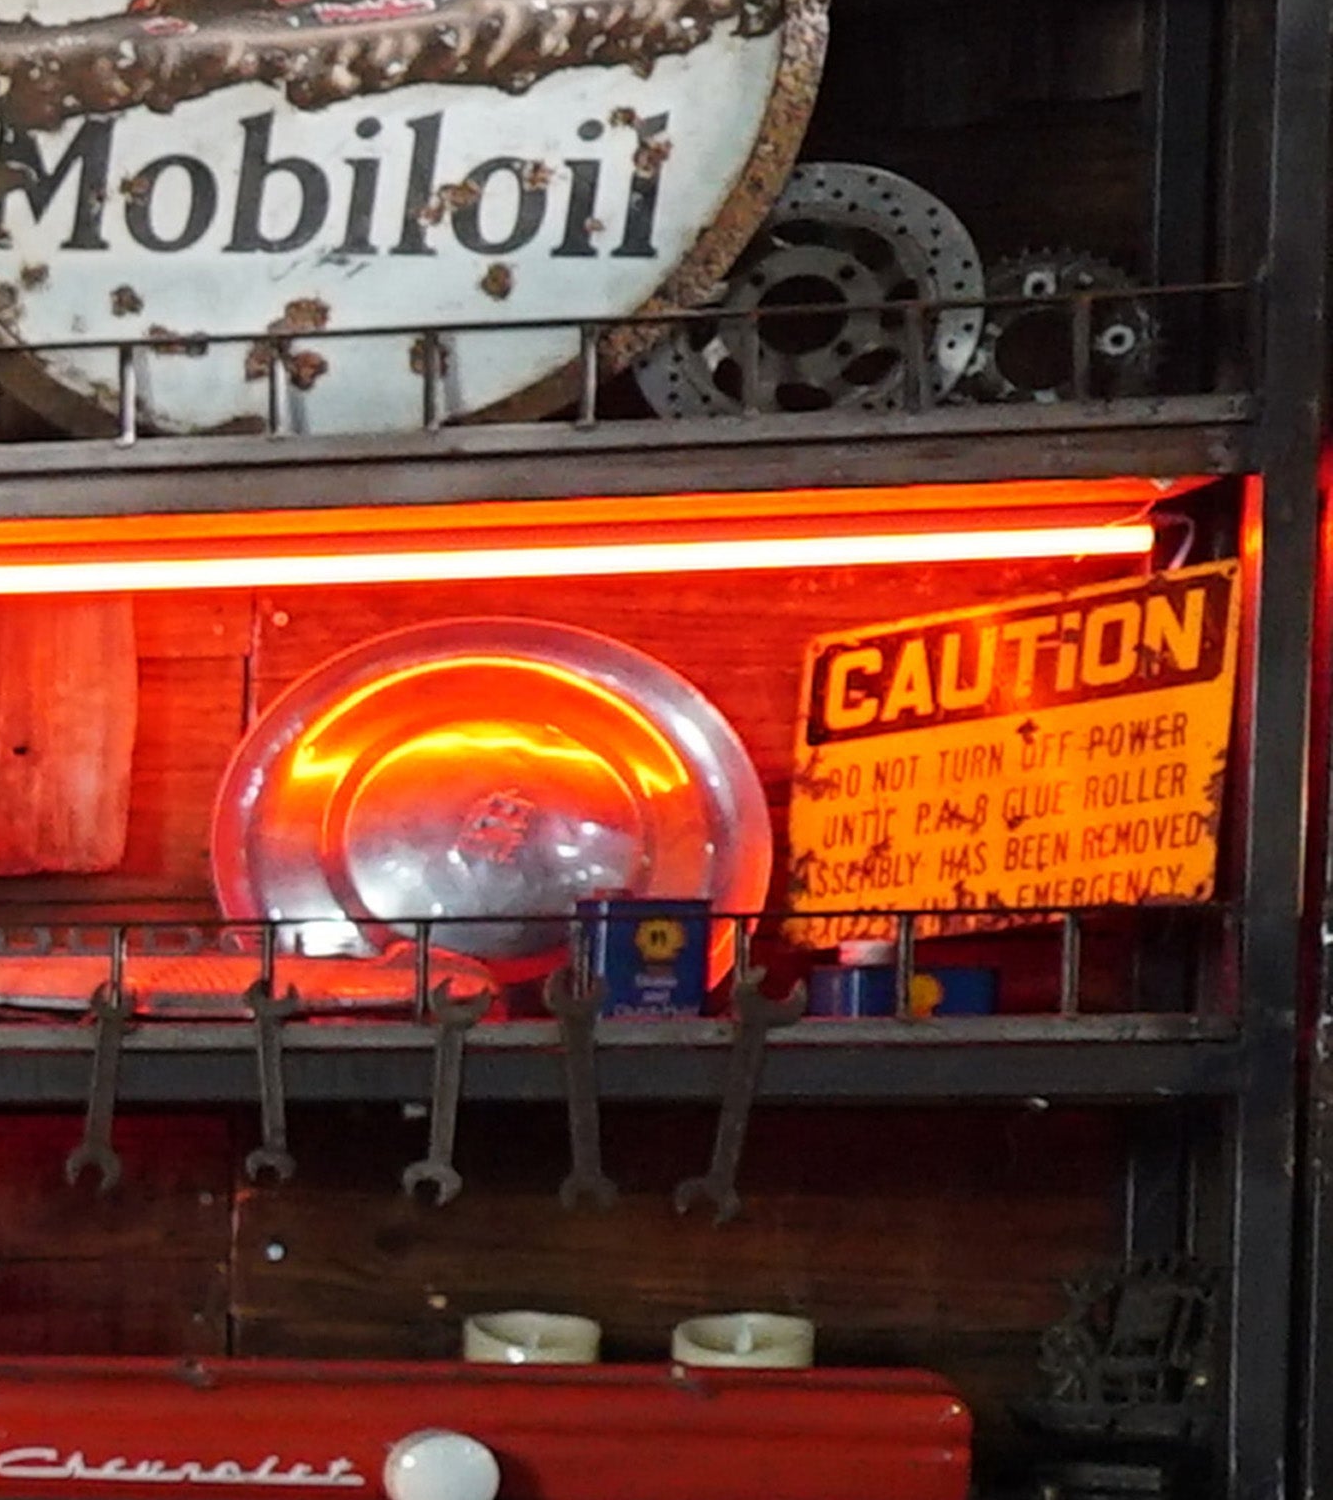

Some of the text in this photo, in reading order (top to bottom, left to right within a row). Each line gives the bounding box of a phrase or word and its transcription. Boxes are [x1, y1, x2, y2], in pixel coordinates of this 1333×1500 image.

[824, 588, 1206, 731] CAUTION
[831, 711, 1188, 800] DO NOT TURN OFF POWER
[1002, 780, 1066, 826] GLUE
[1083, 762, 1188, 810] ROLLER
[800, 810, 1202, 902] ASSEMBLY HAS BEEN REMOVED
